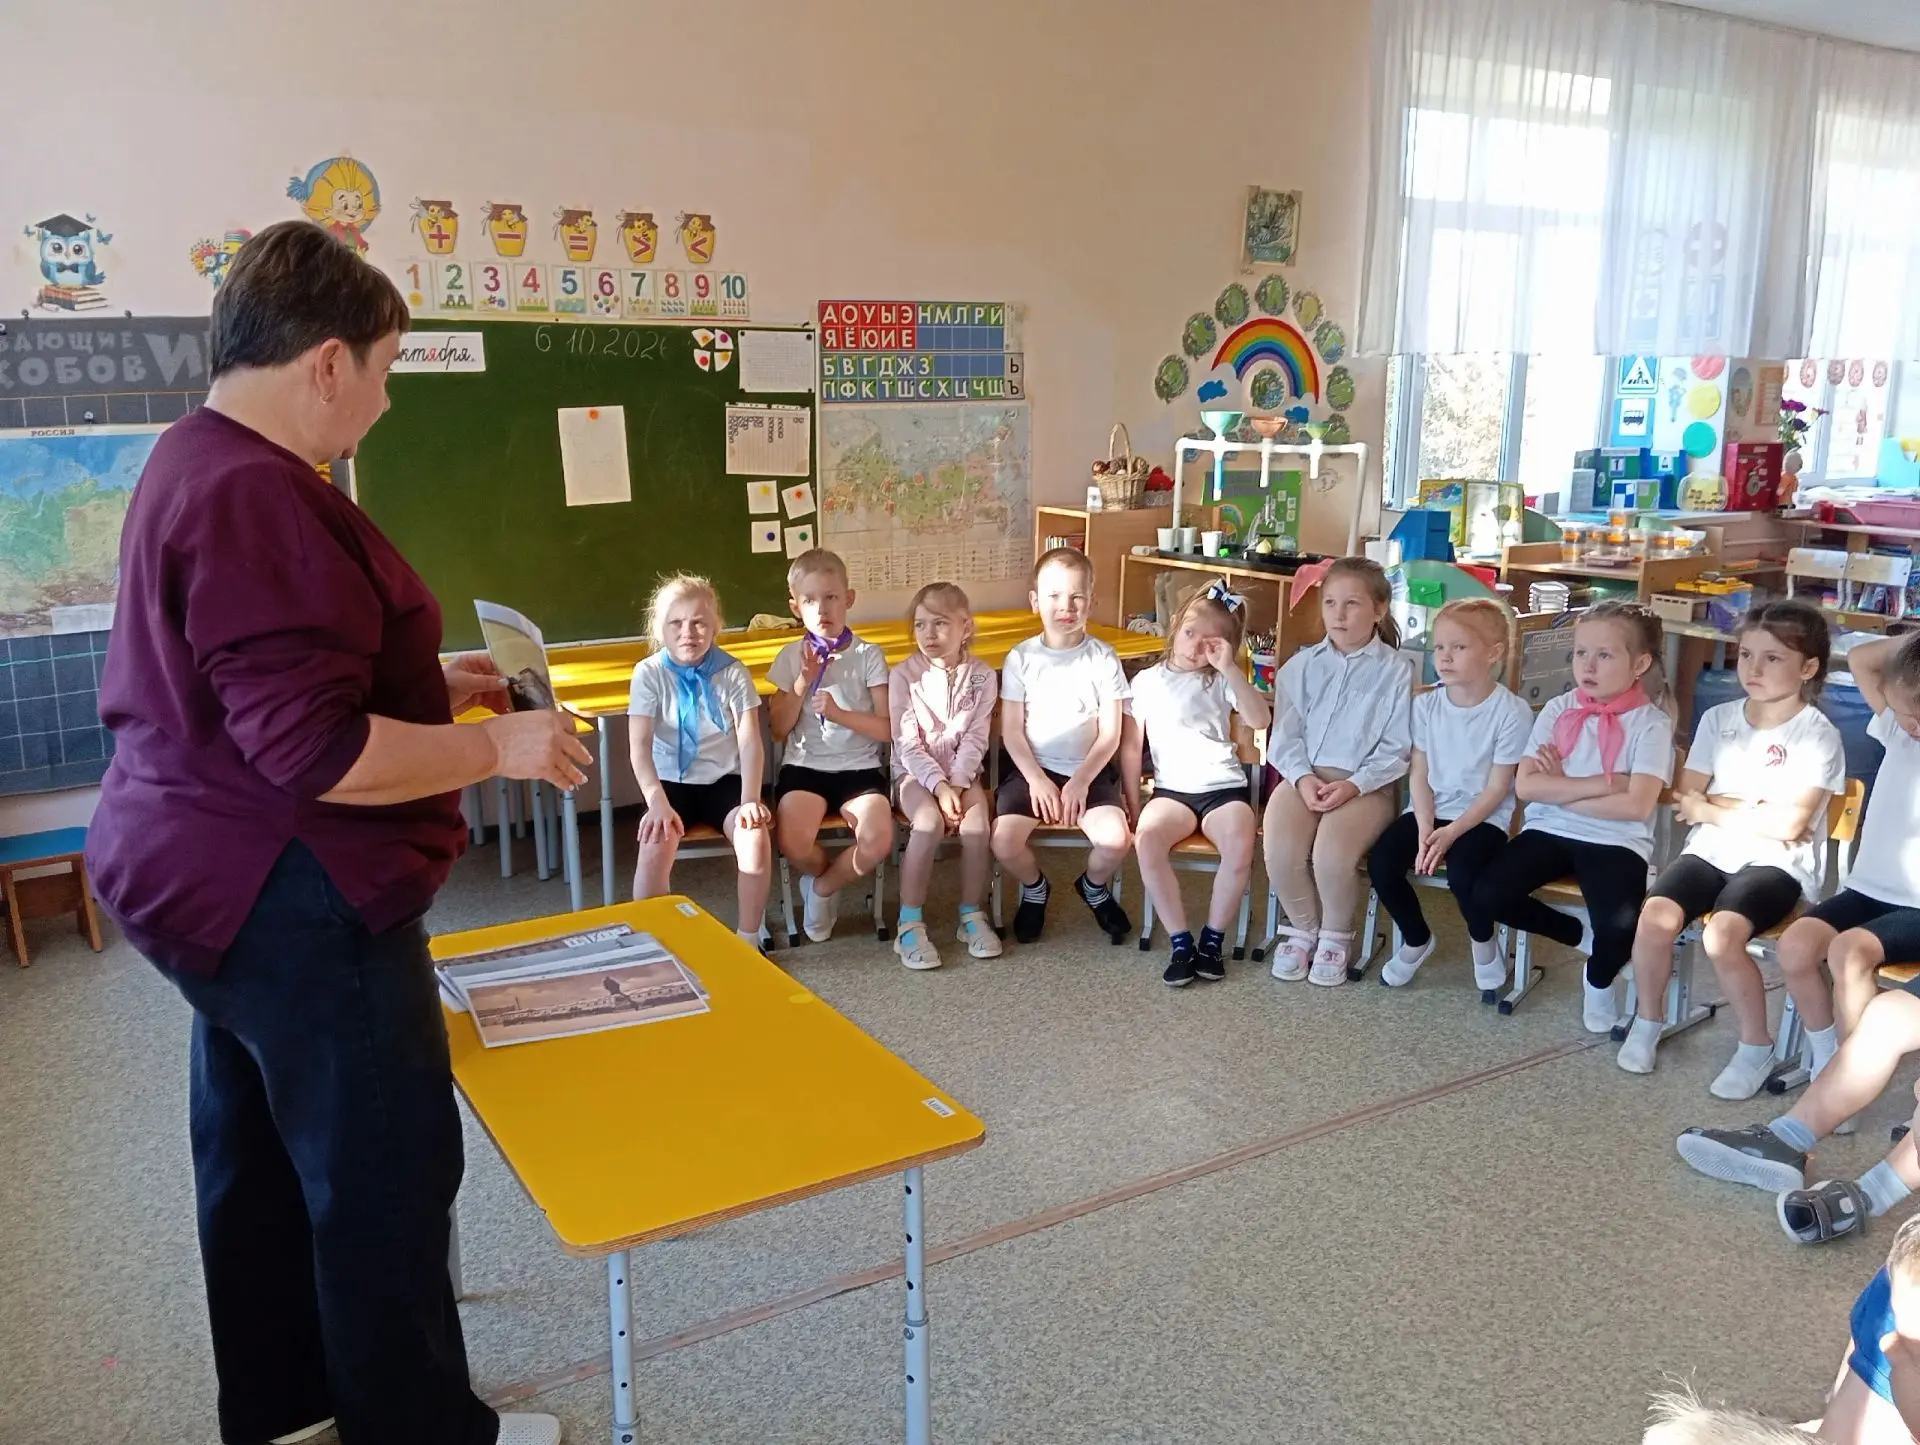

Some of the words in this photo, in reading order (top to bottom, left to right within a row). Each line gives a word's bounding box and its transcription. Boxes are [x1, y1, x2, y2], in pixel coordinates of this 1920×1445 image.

[406, 264, 420, 289] 1
[445, 264, 464, 290] 2
[483, 266, 500, 292] 3
[522, 268, 540, 293] 4
[562, 270, 577, 295] 5
[598, 272, 614, 297] 6
[630, 273, 646, 297] 7
[664, 273, 680, 298] 8
[695, 274, 710, 298] 9
[721, 275, 746, 299] 10
[536, 325, 551, 352] 6
[31, 428, 75, 437] РОССИЯ
